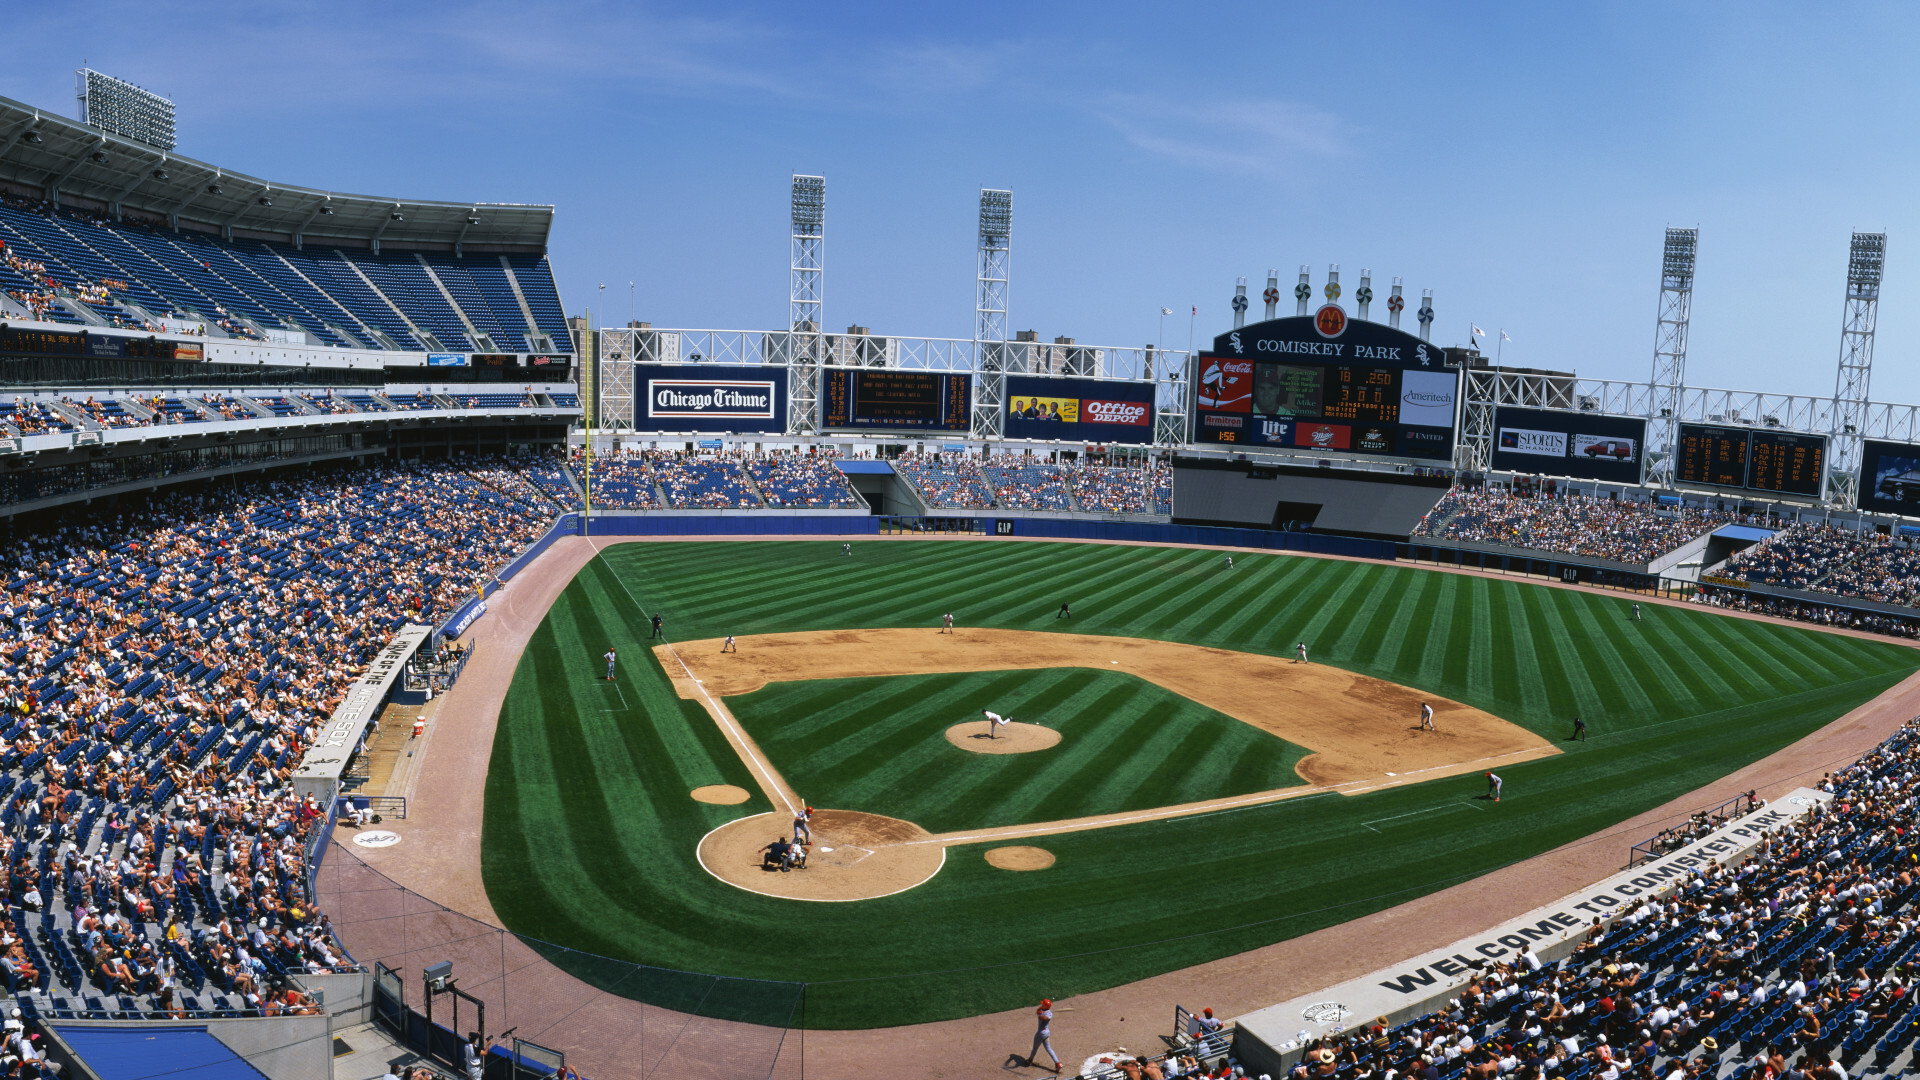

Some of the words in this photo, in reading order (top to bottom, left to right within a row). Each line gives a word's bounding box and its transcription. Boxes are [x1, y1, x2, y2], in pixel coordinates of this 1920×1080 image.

[1257, 339, 1344, 356] COMISKEY
[1354, 345, 1401, 360] PARK
[1340, 370, 1351, 383] 18
[1366, 372, 1391, 385] .250
[657, 389, 712, 410] Chicago
[713, 388, 768, 408] Tribune
[1342, 389, 1349, 401] 3
[1358, 390, 1366, 401] 0
[1375, 392, 1382, 403] 0
[1406, 389, 1452, 402] Ameritech
[1087, 402, 1145, 416] Office
[1093, 414, 1139, 424] DEPOT
[1206, 416, 1241, 425] Armitron
[1261, 420, 1288, 436] Lite
[1219, 431, 1236, 442] 1:56
[1415, 432, 1444, 441] UNITED
[1519, 432, 1563, 448] SPORTS
[1519, 444, 1562, 454] CHANNEL
[998, 522, 1011, 534] GAP
[1563, 568, 1577, 580] GAP
[385, 640, 412, 660] HOME
[378, 660, 395, 670] OF
[364, 671, 389, 685] THE
[340, 687, 378, 720] WHITE
[322, 722, 356, 748] SOX
[1378, 911, 1582, 994] WELCOME
[1573, 895, 1620, 915] TO
[1614, 835, 1739, 896] COMISKEY
[1731, 809, 1790, 838] PARK
